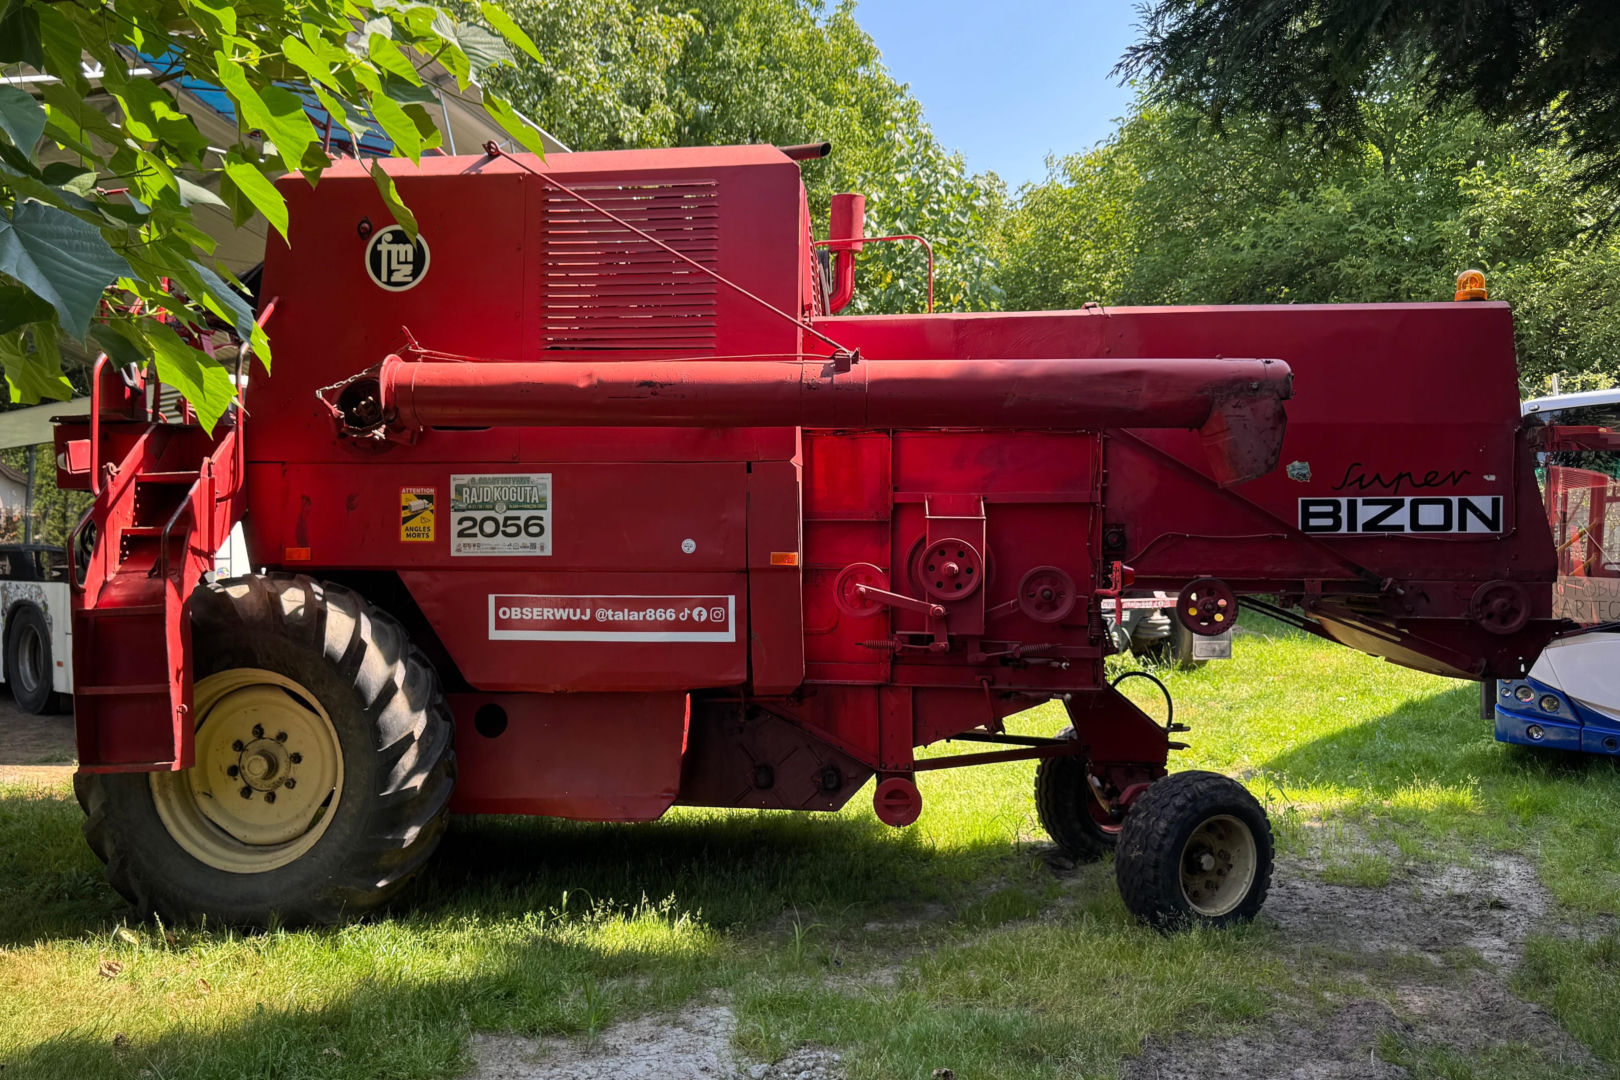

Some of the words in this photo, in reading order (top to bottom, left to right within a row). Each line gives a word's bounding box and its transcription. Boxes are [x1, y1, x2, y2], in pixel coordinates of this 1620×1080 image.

[1331, 462, 1471, 495] Super
[462, 486, 491, 504] RAJD
[493, 485, 540, 504] KOGUTA
[456, 515, 546, 538] 2056
[1300, 497, 1502, 533] BIZON
[498, 606, 591, 621] OBSERWUJ
[595, 607, 676, 622] @talar866
